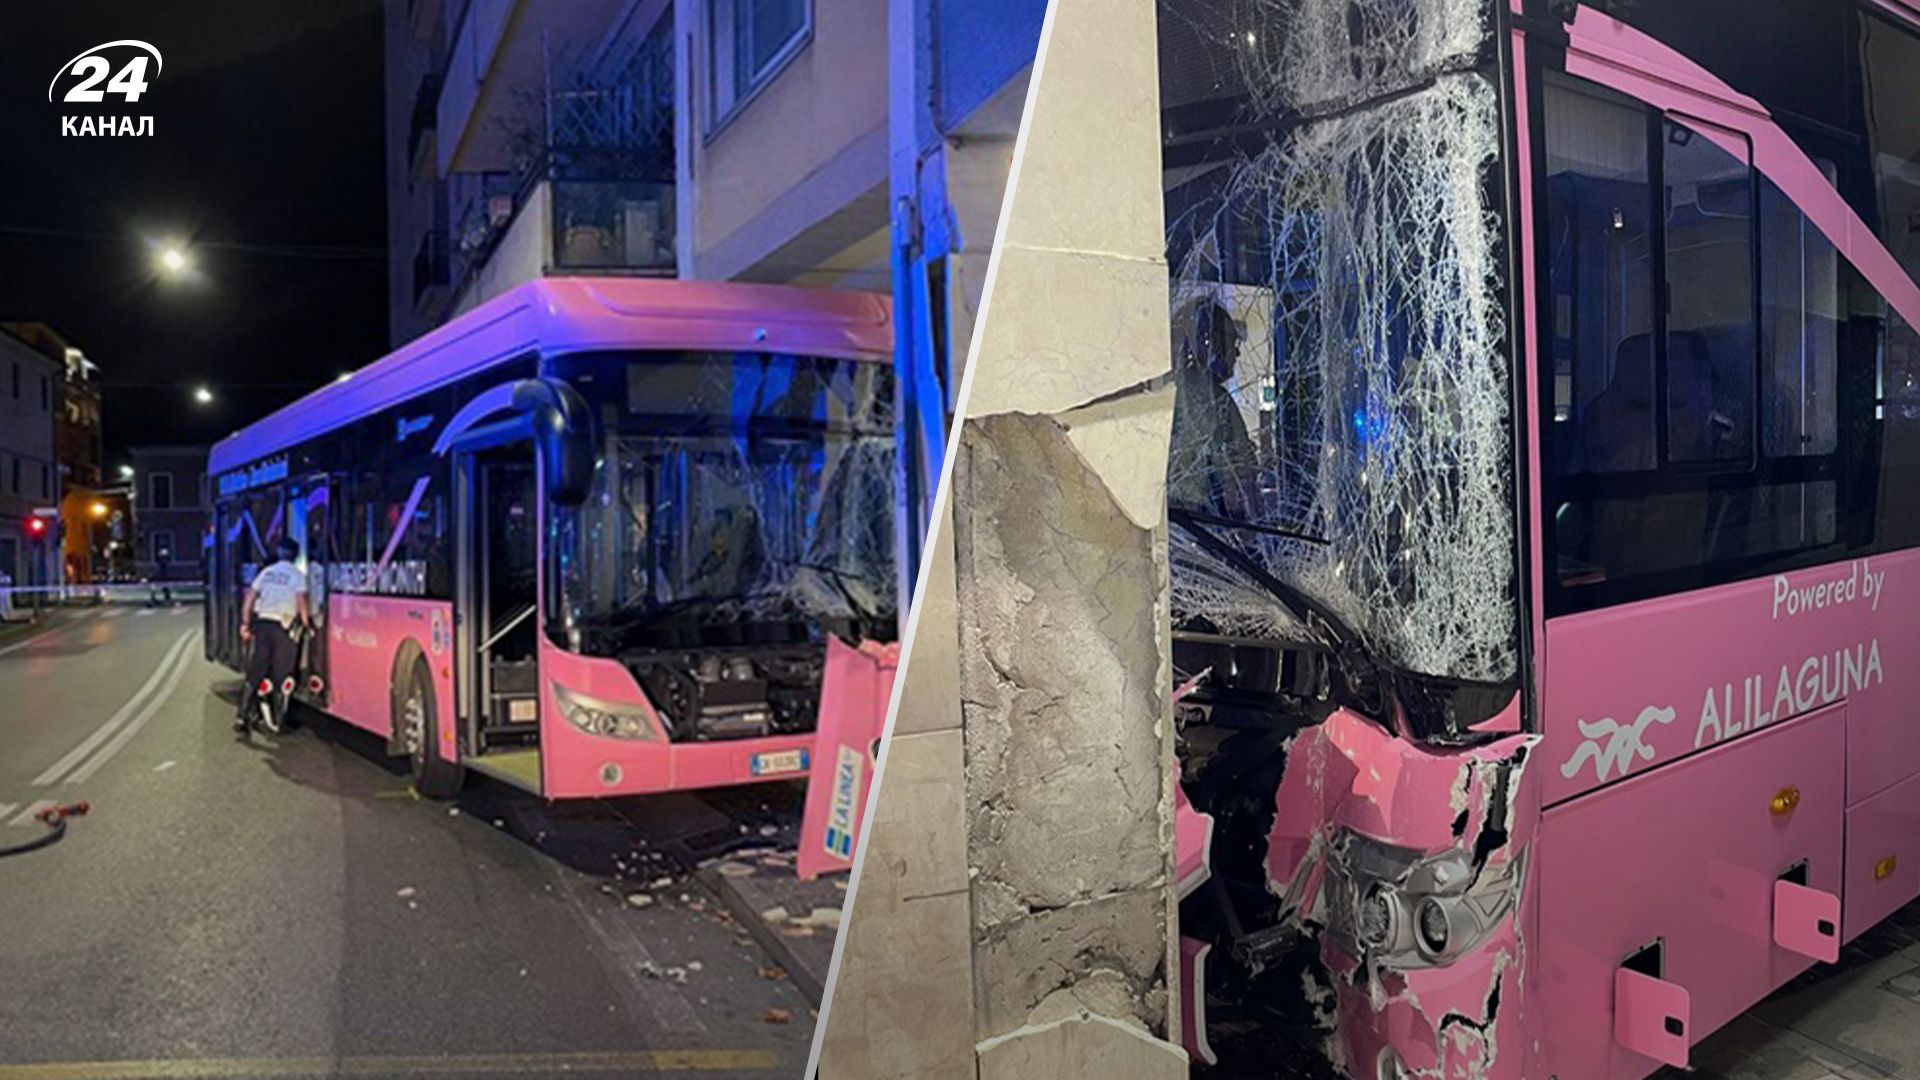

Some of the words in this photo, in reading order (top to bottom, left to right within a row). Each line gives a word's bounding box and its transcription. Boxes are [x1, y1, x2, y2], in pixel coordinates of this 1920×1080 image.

[1772, 561, 1858, 618] Powered
[1862, 559, 1885, 610] by
[1694, 639, 1883, 748] ALILAGUNA
